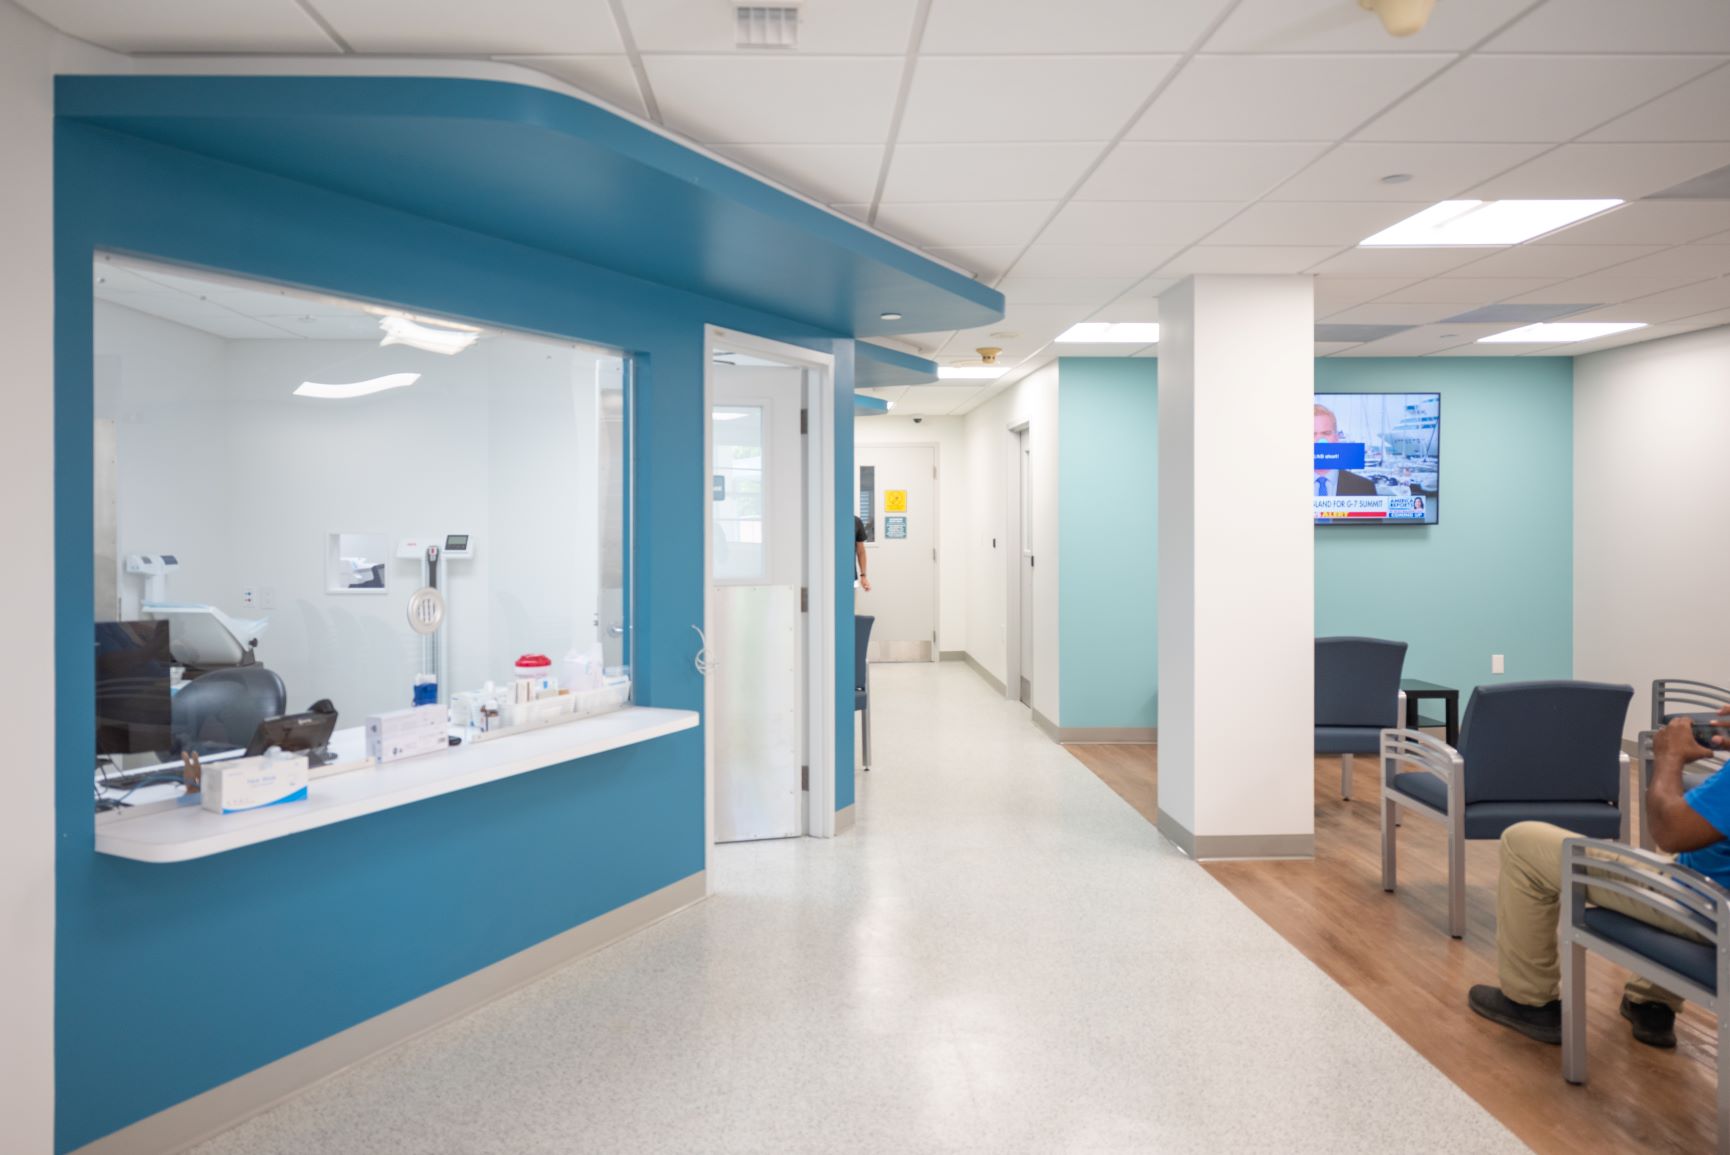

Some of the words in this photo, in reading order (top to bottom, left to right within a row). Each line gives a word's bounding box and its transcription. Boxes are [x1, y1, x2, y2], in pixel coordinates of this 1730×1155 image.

[1333, 500, 1345, 508] FOR
[1346, 500, 1358, 508] G-7
[1359, 500, 1383, 508] SUMMIT
